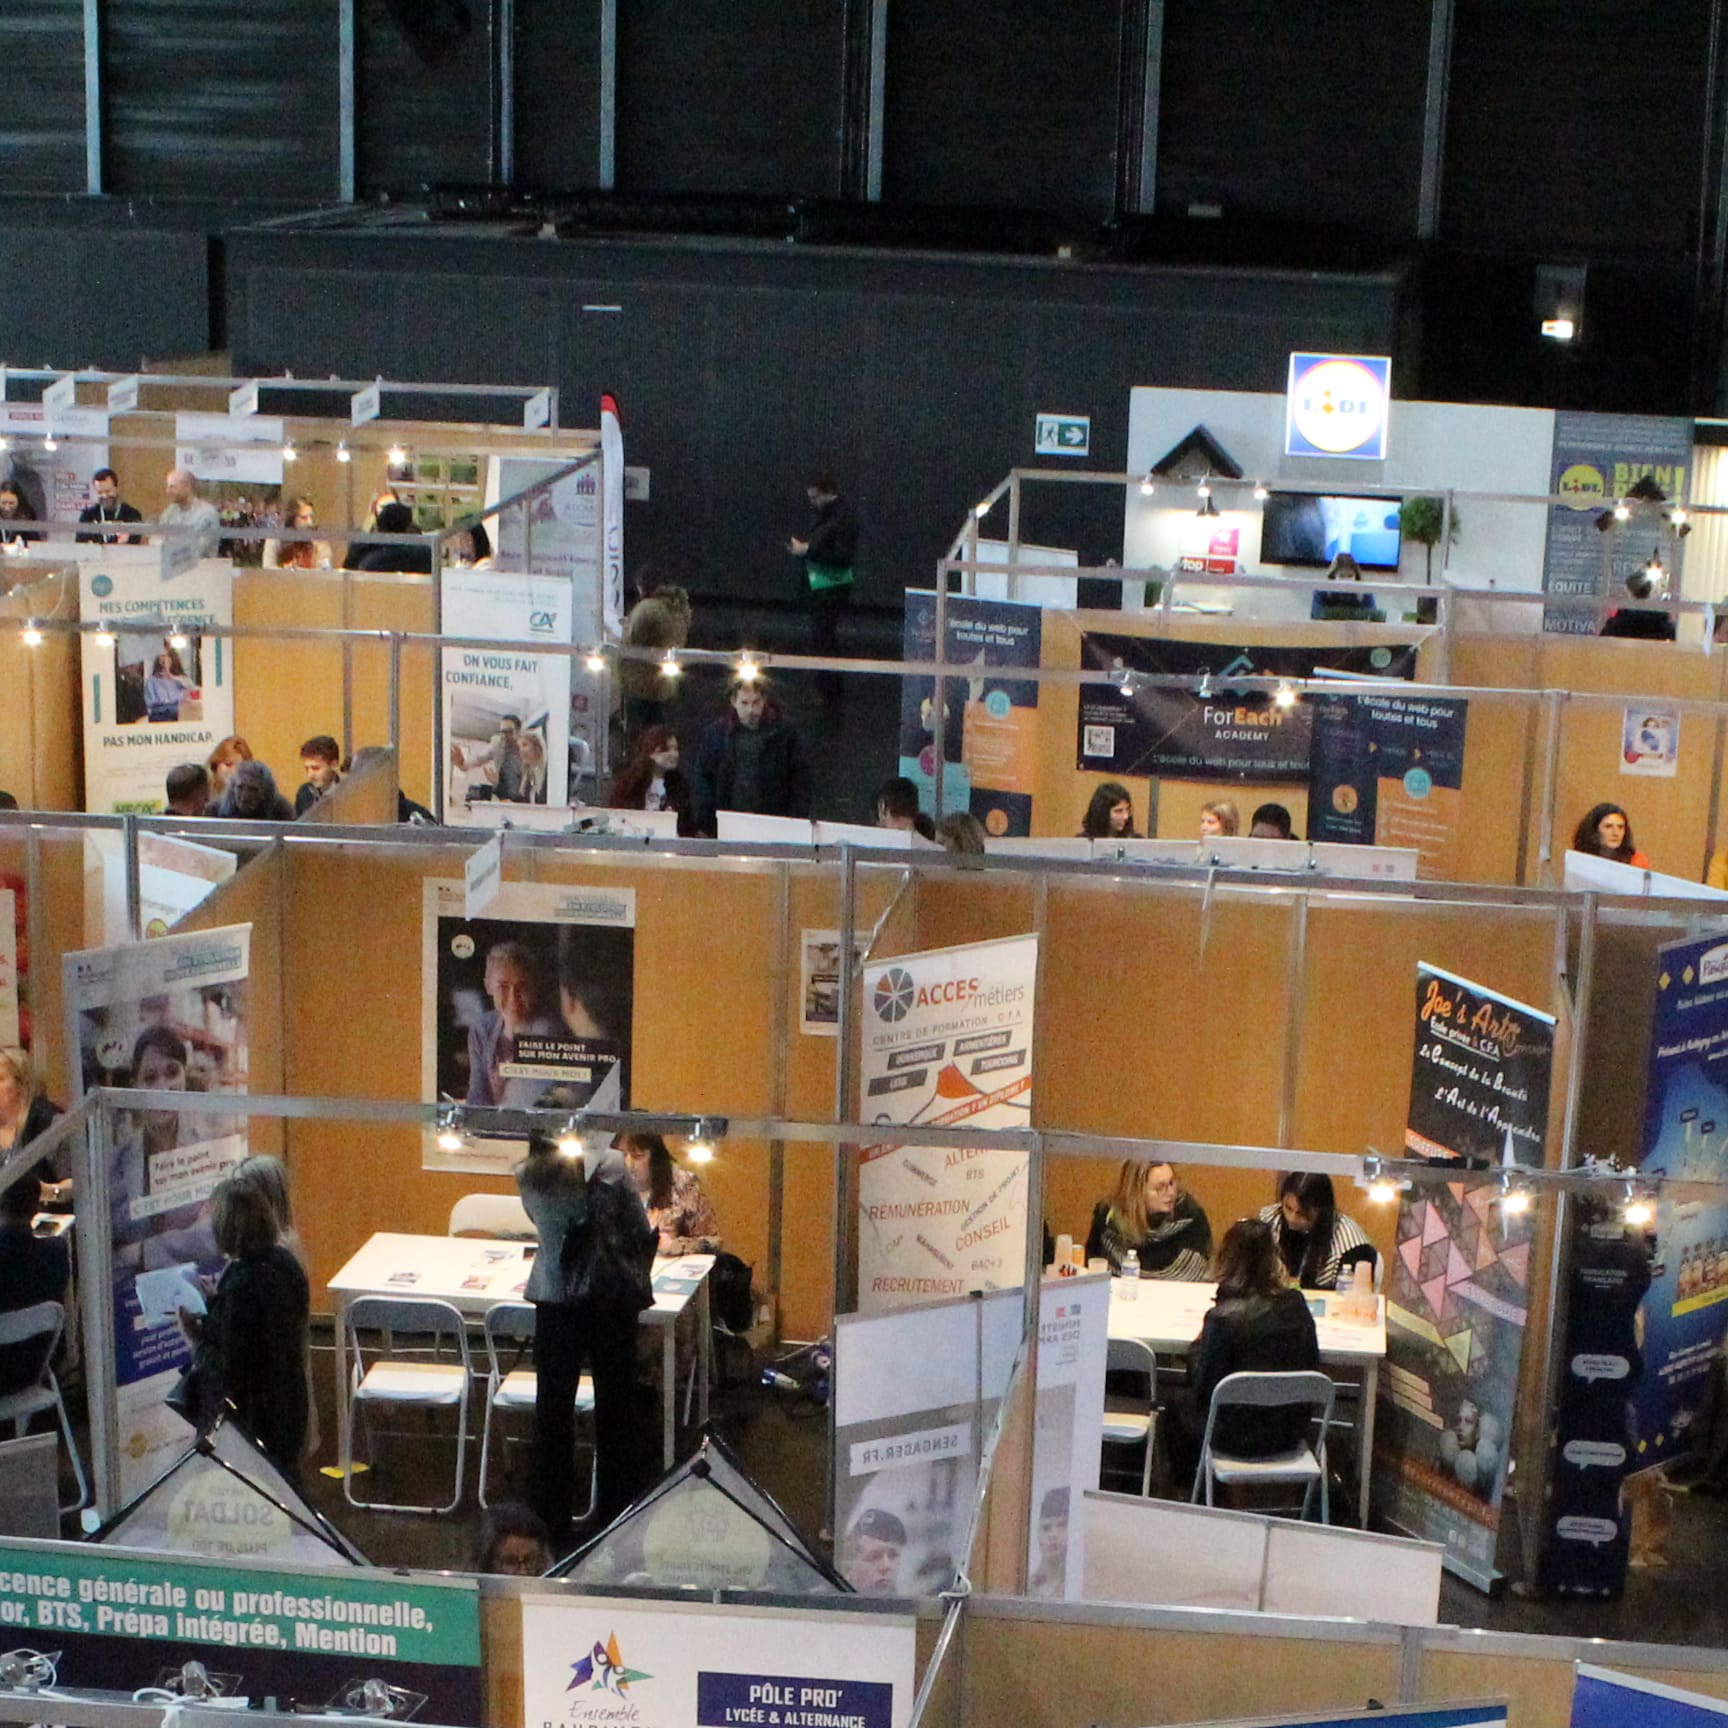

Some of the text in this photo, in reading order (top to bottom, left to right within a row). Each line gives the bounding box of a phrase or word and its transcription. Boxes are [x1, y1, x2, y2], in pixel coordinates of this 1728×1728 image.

[482, 655, 538, 673] VOUS FAIT
[1203, 704, 1284, 727] ForEach
[1391, 698, 1430, 715] du web
[1416, 715, 1439, 729] tous
[102, 733, 153, 748] PAS MON
[1214, 730, 1270, 742] ACADEMY
[916, 977, 1026, 1009] ACCES métiers
[1421, 980, 1468, 1024] Joe's
[872, 1015, 989, 1046] CENTRE DE FORMATION
[562, 1051, 597, 1063] AVENIR
[954, 1217, 1011, 1252] CONSEIL
[871, 1276, 967, 1294] RECRUTEMENT
[78, 1570, 187, 1614] générale
[194, 1587, 225, 1612] ou
[231, 1584, 433, 1633] professionnelle,
[36, 1599, 90, 1633] BTS,
[96, 1603, 169, 1641] Prépa
[175, 1611, 287, 1651] intégrée,
[295, 1622, 396, 1657] Mention
[749, 1682, 796, 1707] PÔLE
[725, 1705, 765, 1724] LYCÉE
